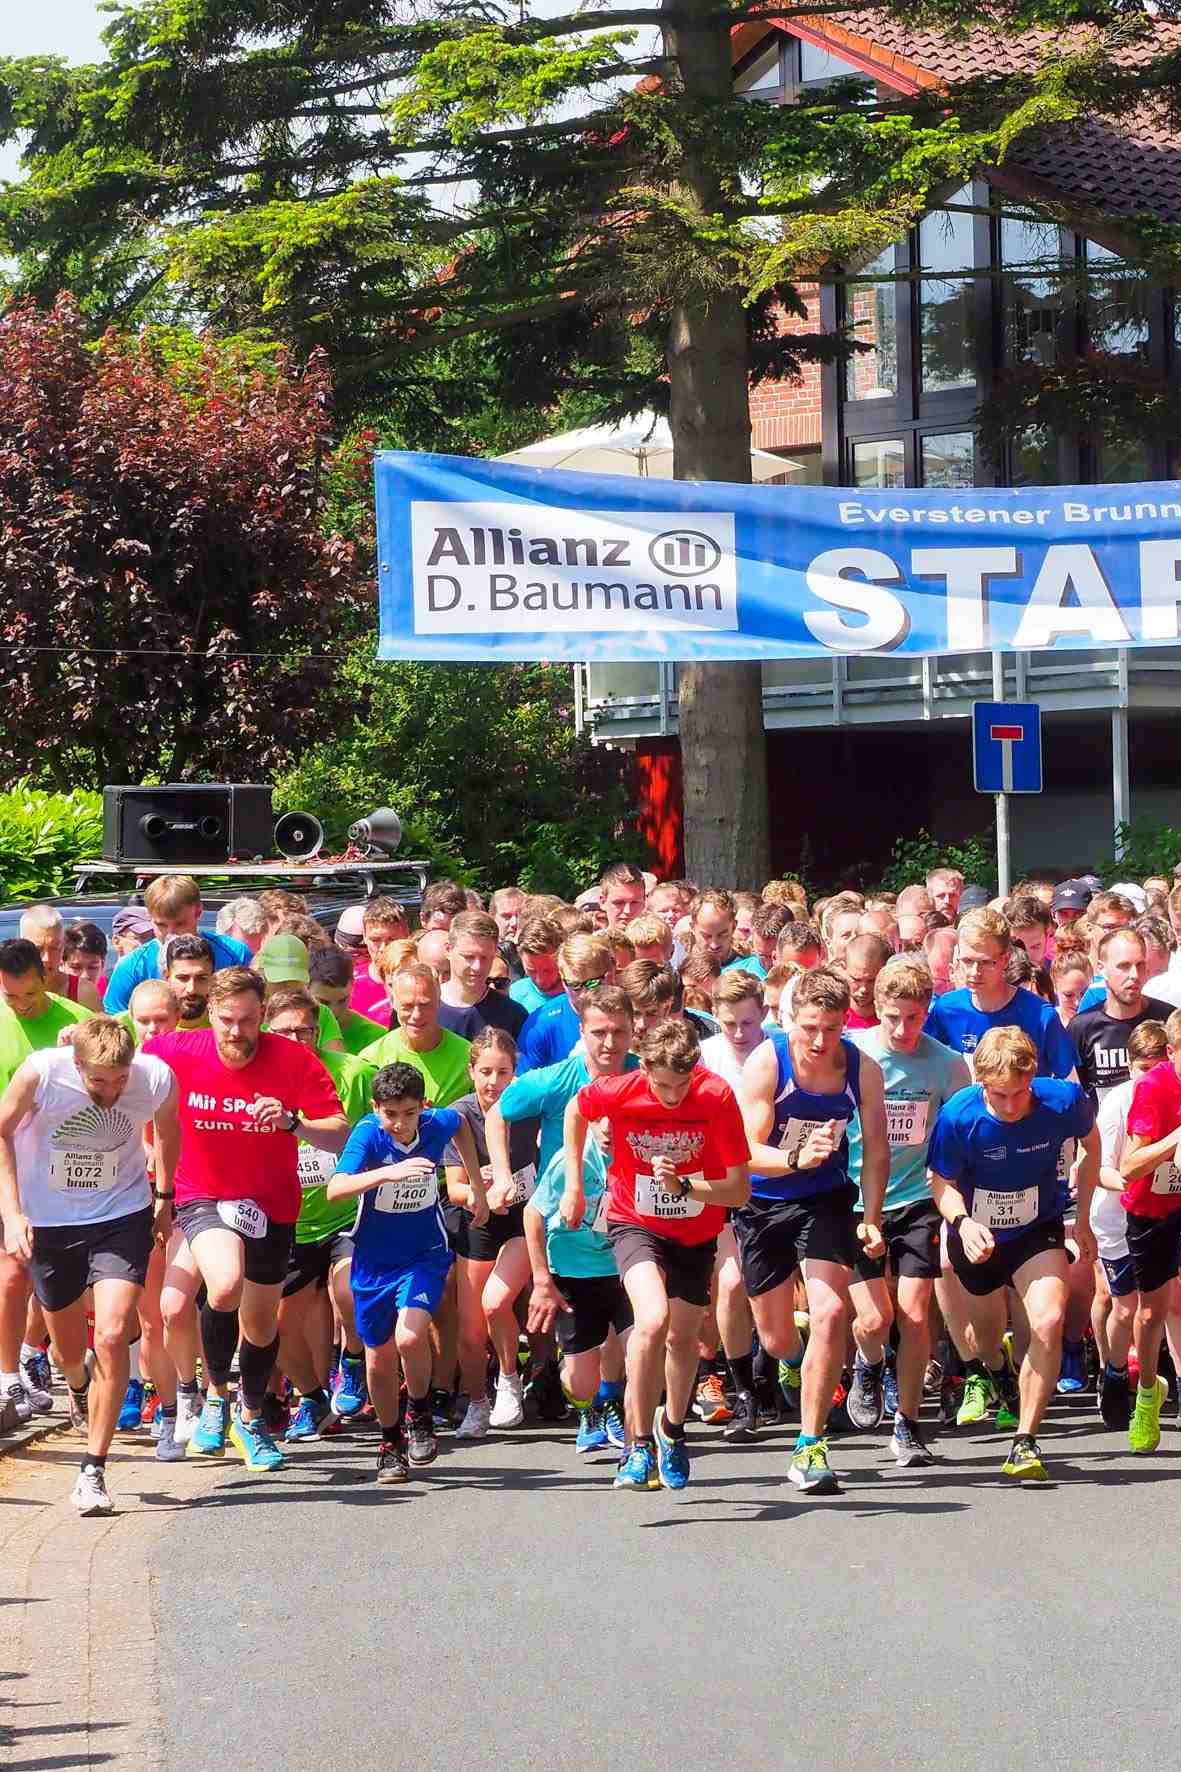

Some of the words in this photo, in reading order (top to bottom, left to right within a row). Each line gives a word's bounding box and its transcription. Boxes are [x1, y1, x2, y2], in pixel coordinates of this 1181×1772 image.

[838, 501, 1051, 526] Everstener
[426, 527, 632, 567] Allianz
[428, 575, 476, 612] D.
[491, 572, 723, 612] Baumann
[1093, 1042, 1131, 1068] bru
[188, 1091, 217, 1112] Mit
[223, 1097, 256, 1116] SPe
[194, 1119, 235, 1131] zum
[888, 1133, 910, 1142] runs
[64, 1152, 93, 1160] Allianz
[65, 1166, 103, 1178] 1072
[66, 1177, 99, 1189] bruns
[394, 1188, 427, 1200] 1400
[392, 1199, 422, 1211] bruns
[654, 1204, 687, 1217] bruns
[998, 1206, 1014, 1216] 31
[238, 1203, 260, 1222] 540
[990, 1215, 1021, 1226] bruns
